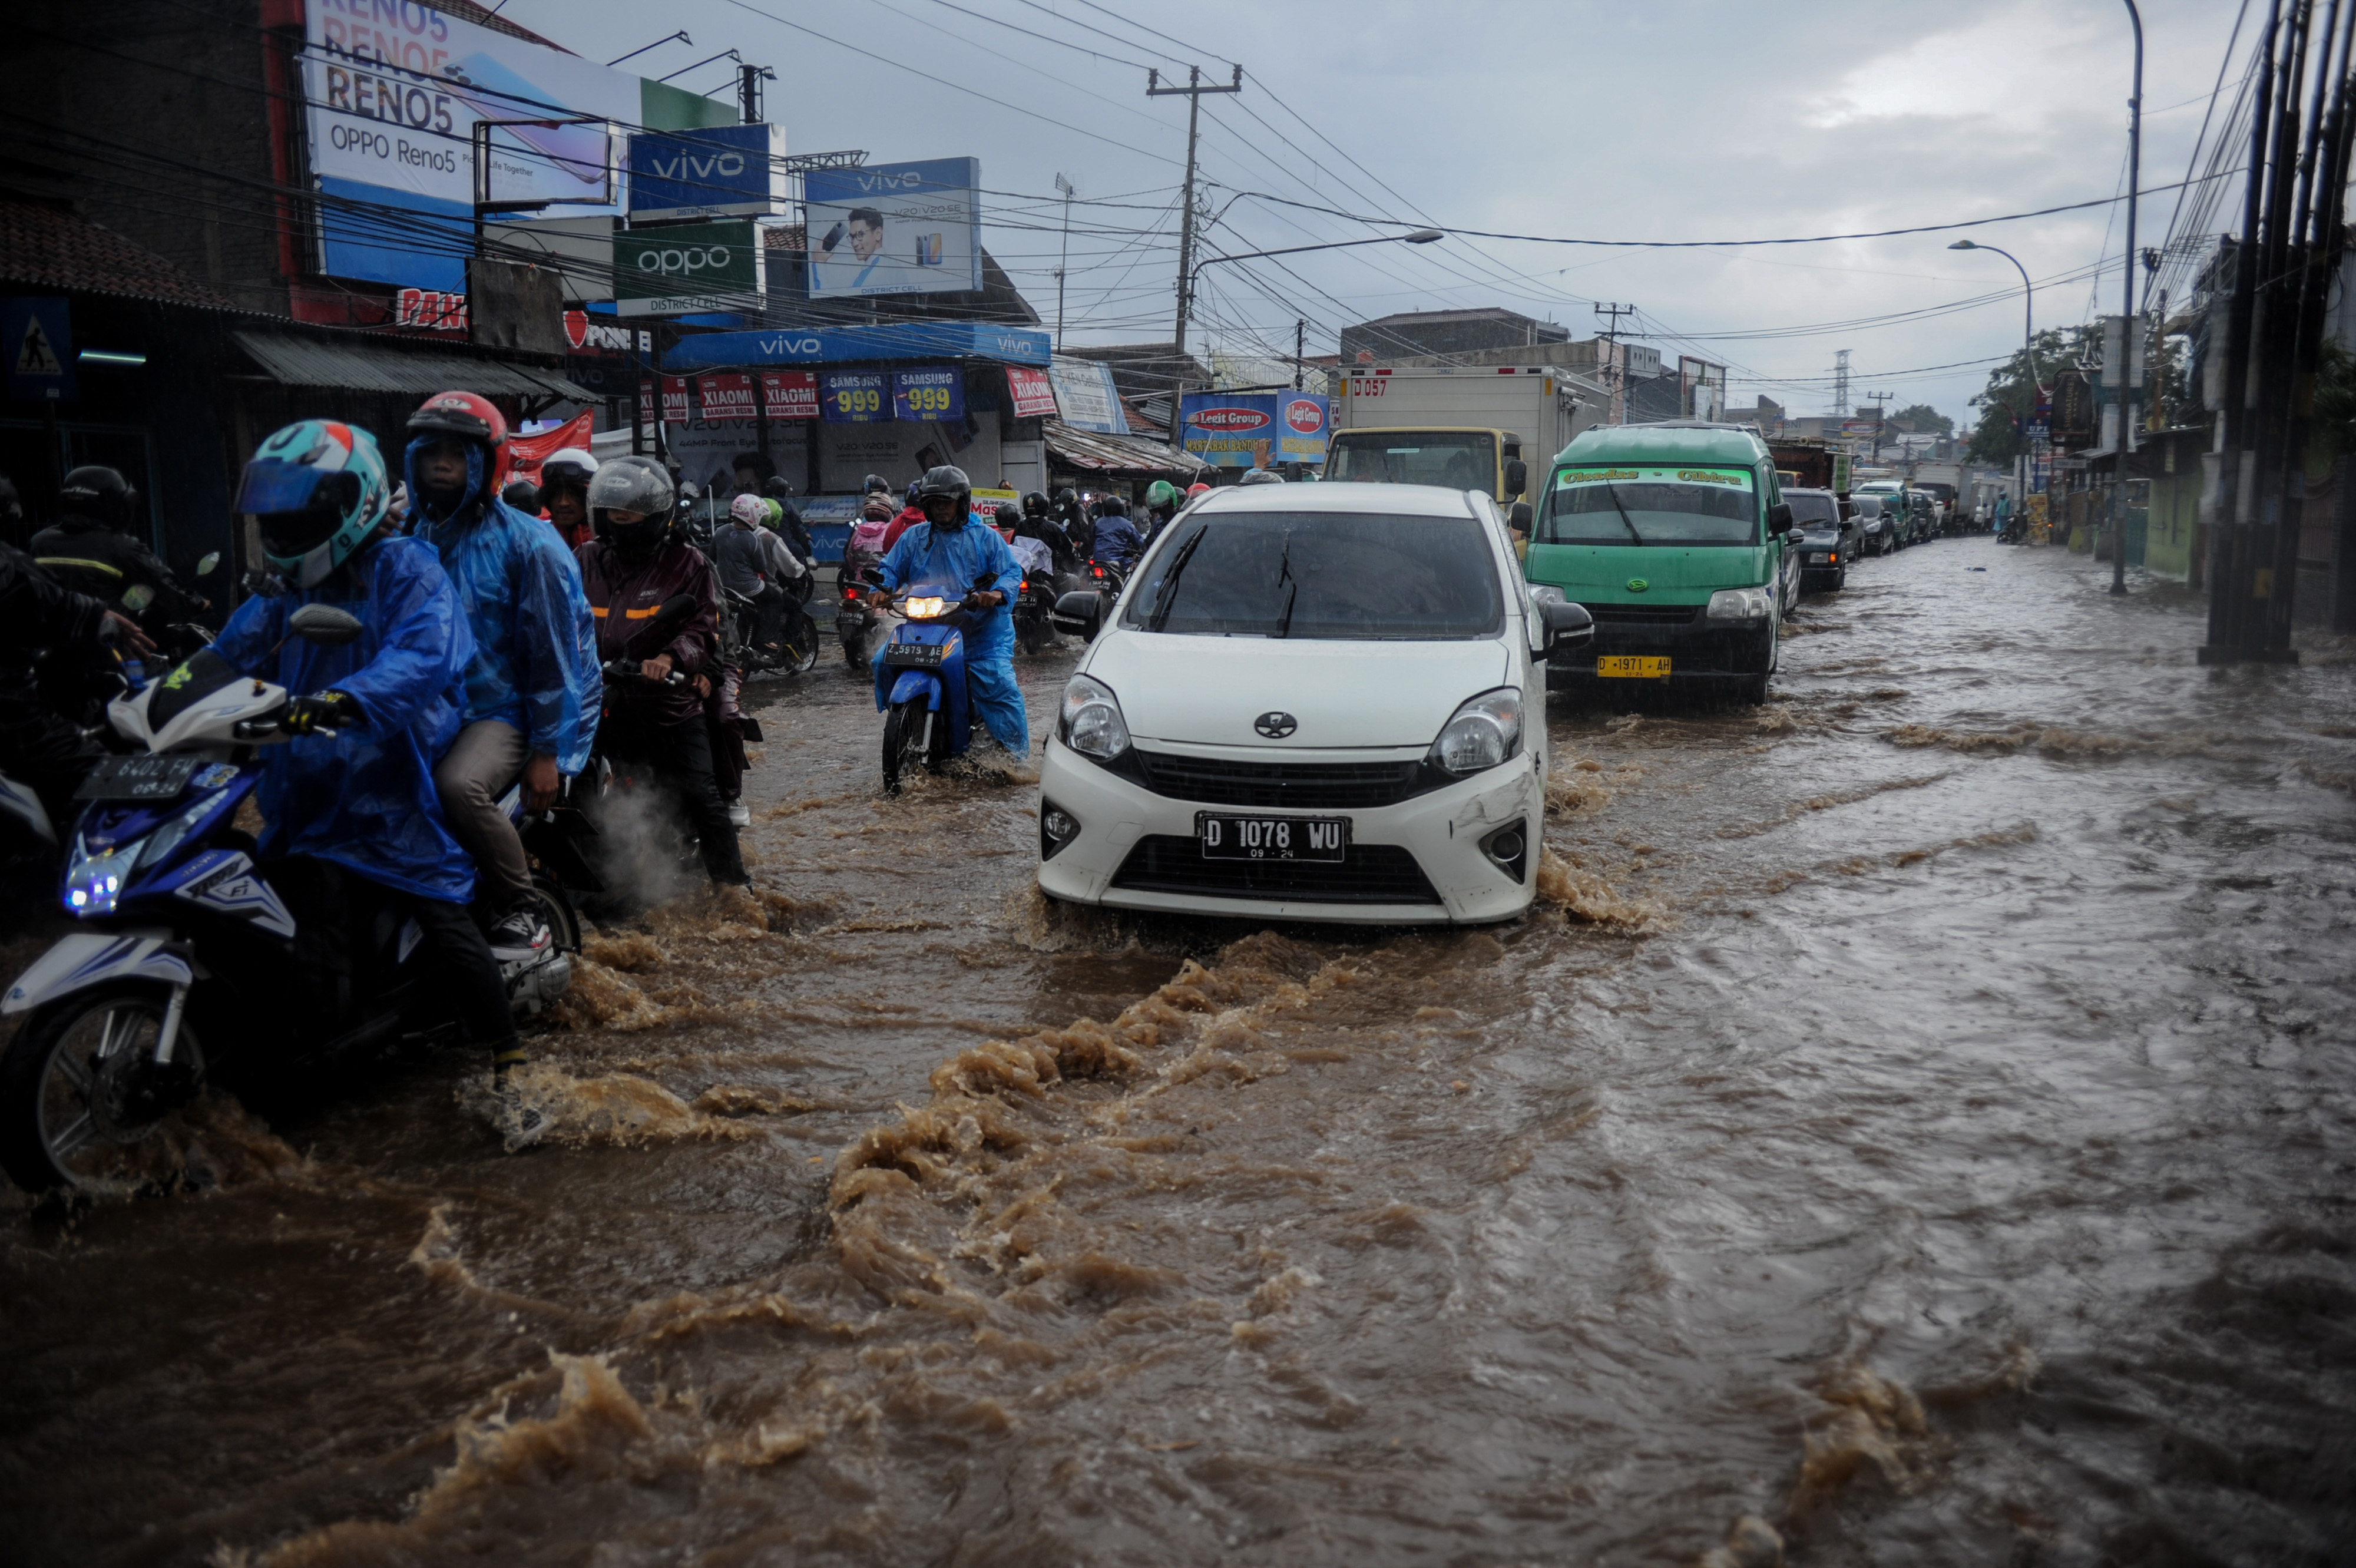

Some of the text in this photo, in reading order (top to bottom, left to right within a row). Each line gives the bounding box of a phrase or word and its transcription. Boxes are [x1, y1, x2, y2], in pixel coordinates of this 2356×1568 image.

[326, 65, 453, 134] RENO5
[331, 124, 455, 173] OPPO Reno5
[504, 163, 533, 177] Together
[652, 148, 744, 179] vivo
[857, 170, 921, 191] vivo
[677, 207, 703, 216] DISTRICT
[895, 207, 918, 216] V20
[922, 205, 945, 214] V20
[638, 246, 730, 276] oppo
[651, 297, 722, 310] DISTRICT CELL
[759, 335, 819, 355] vivo
[997, 334, 1031, 355] vivo
[829, 375, 881, 388] SAMSUNG
[901, 373, 953, 385] SAMSUNG
[1365, 379, 1387, 396] 057
[640, 393, 687, 409] XIOMI
[703, 390, 754, 406] XIAOMI
[766, 388, 816, 403] XIAOMI
[837, 389, 879, 413] 999
[908, 387, 950, 411] 999
[706, 406, 755, 416] GARANSI RESMI
[1018, 402, 1042, 411] GARANSI
[2064, 381, 2074, 429] SIGNATURE
[1200, 412, 1262, 426] Legit Group
[1290, 405, 1304, 422] Legit
[1304, 411, 1321, 426] Group
[710, 439, 736, 447] Front
[739, 438, 756, 449] Eye
[765, 436, 808, 445] utofocus
[1186, 438, 1229, 452] MARTABAK
[1563, 469, 1639, 484] Cicadas
[1677, 469, 1742, 485] Cibiru
[971, 502, 998, 515] Mas
[810, 535, 848, 548] vivo
[888, 645, 942, 656] Z 5979 AE
[1599, 658, 1670, 670] D 1971 AH
[118, 760, 165, 776] 6402
[1207, 819, 1339, 849] D 1078 WU
[1250, 849, 1293, 859] 09 24
